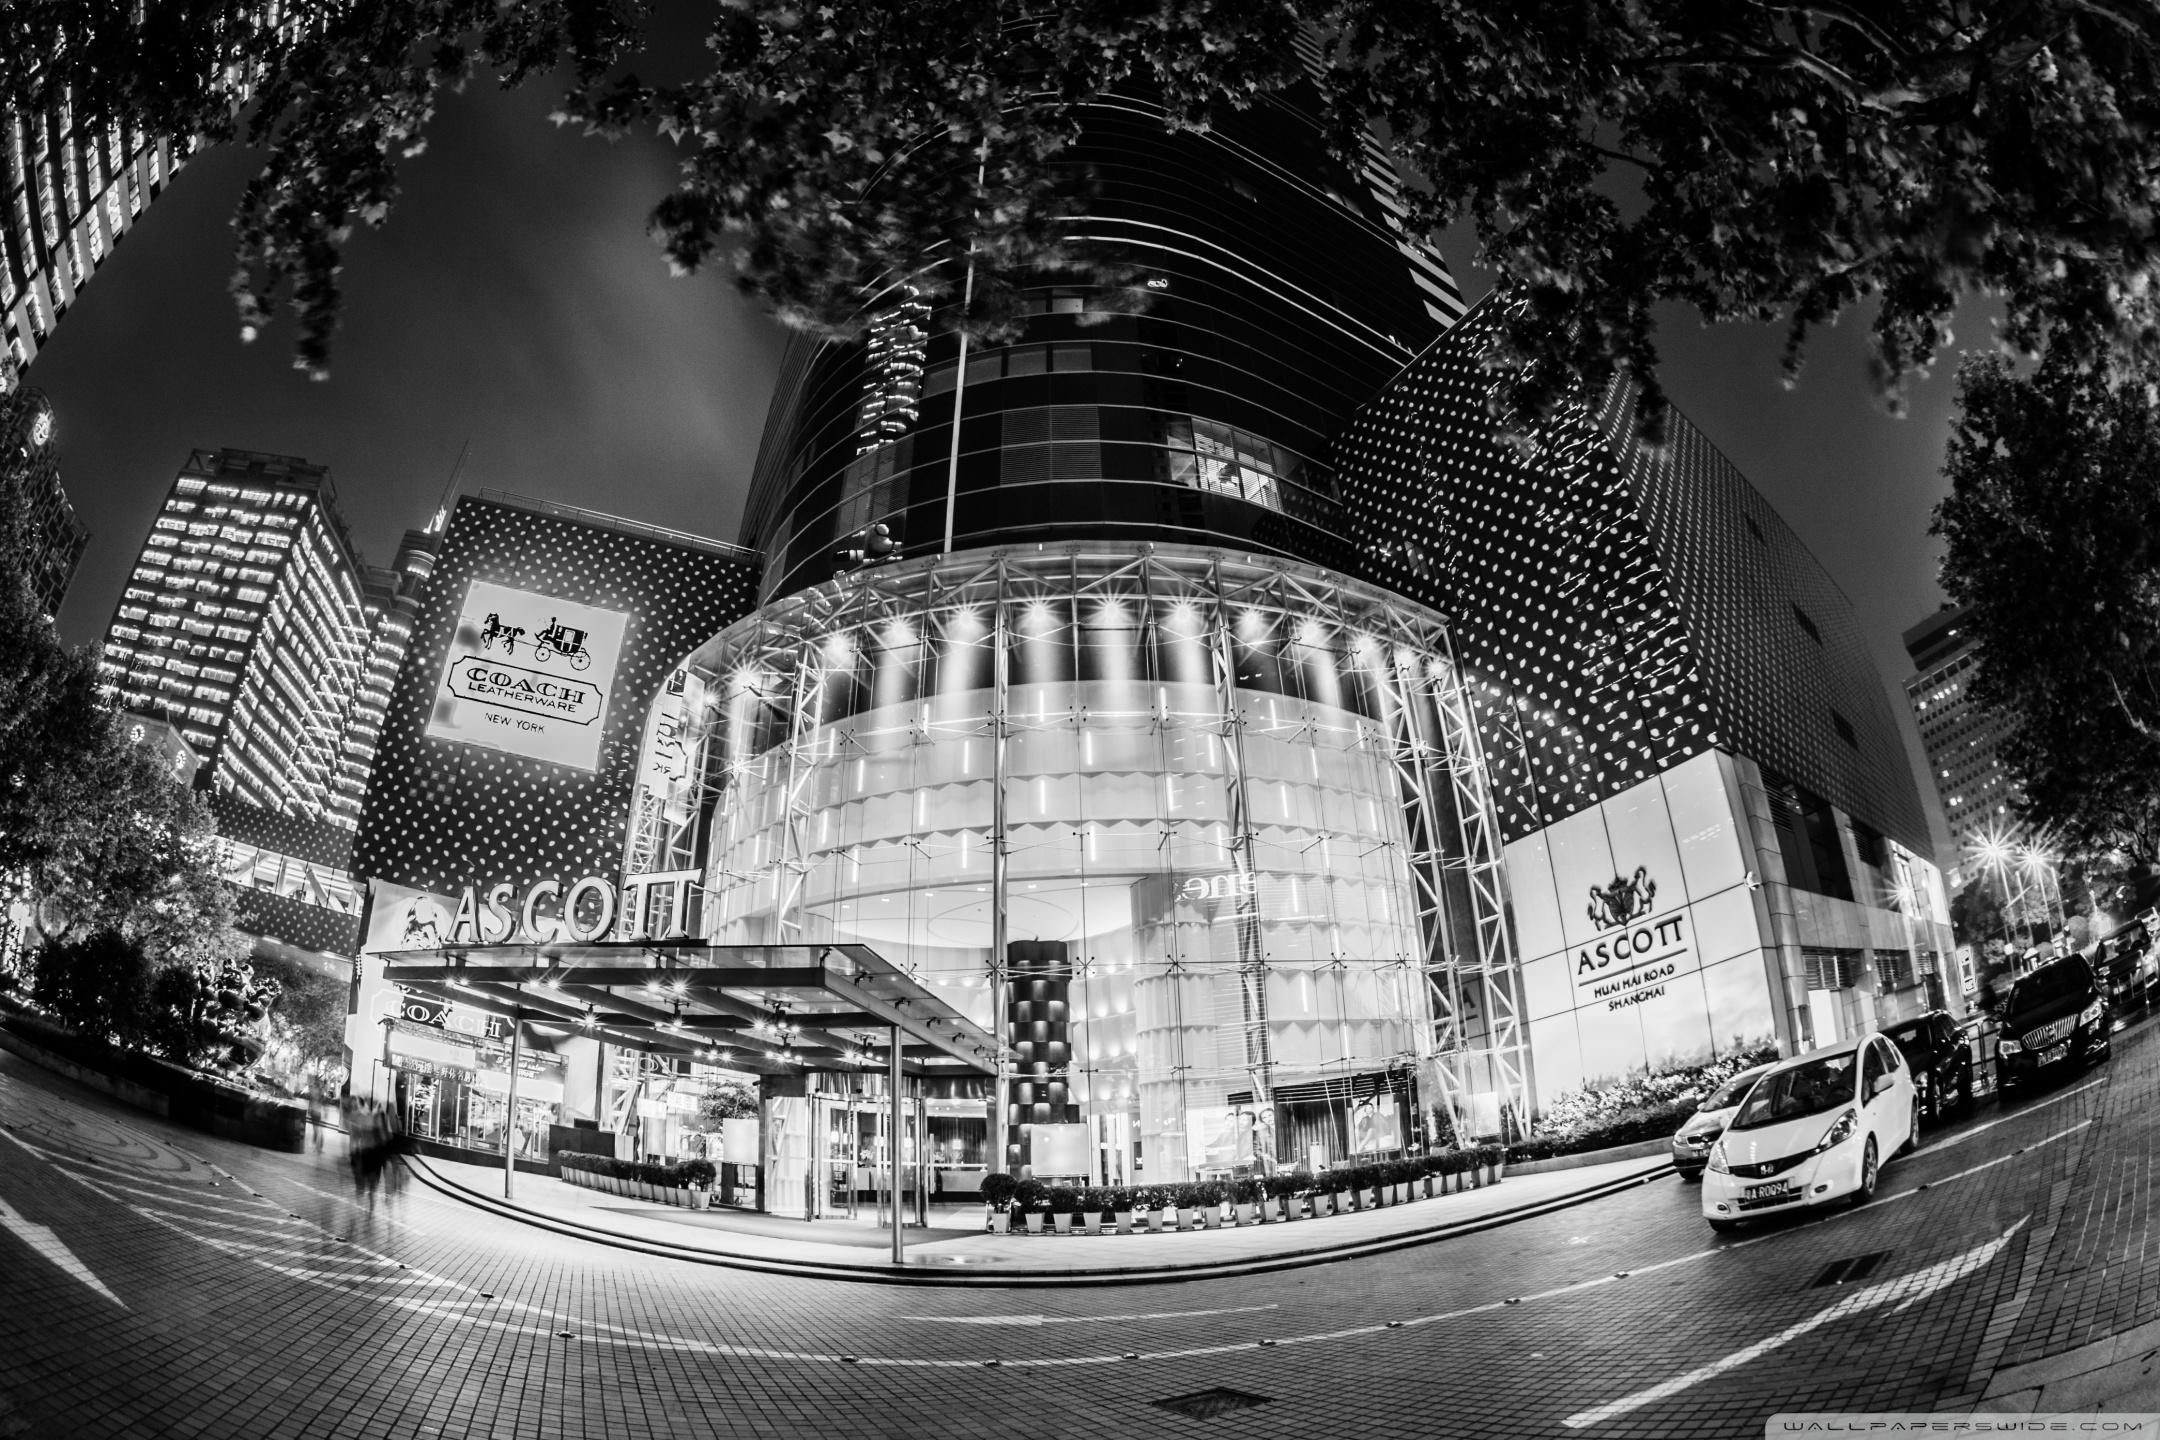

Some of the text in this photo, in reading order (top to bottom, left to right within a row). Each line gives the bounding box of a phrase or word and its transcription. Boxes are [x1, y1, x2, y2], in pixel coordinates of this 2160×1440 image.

[466, 667, 586, 704] COACH
[468, 682, 576, 712] LEATHERWARE
[485, 712, 545, 734] NEW YORK
[446, 868, 702, 943] ASCOTT
[1578, 915, 1683, 975] ASCOTT
[1594, 964, 1675, 998] HUAI MAI ROAD
[1609, 986, 1665, 1011] SHANGHAI
[385, 1000, 502, 1038] COACH
